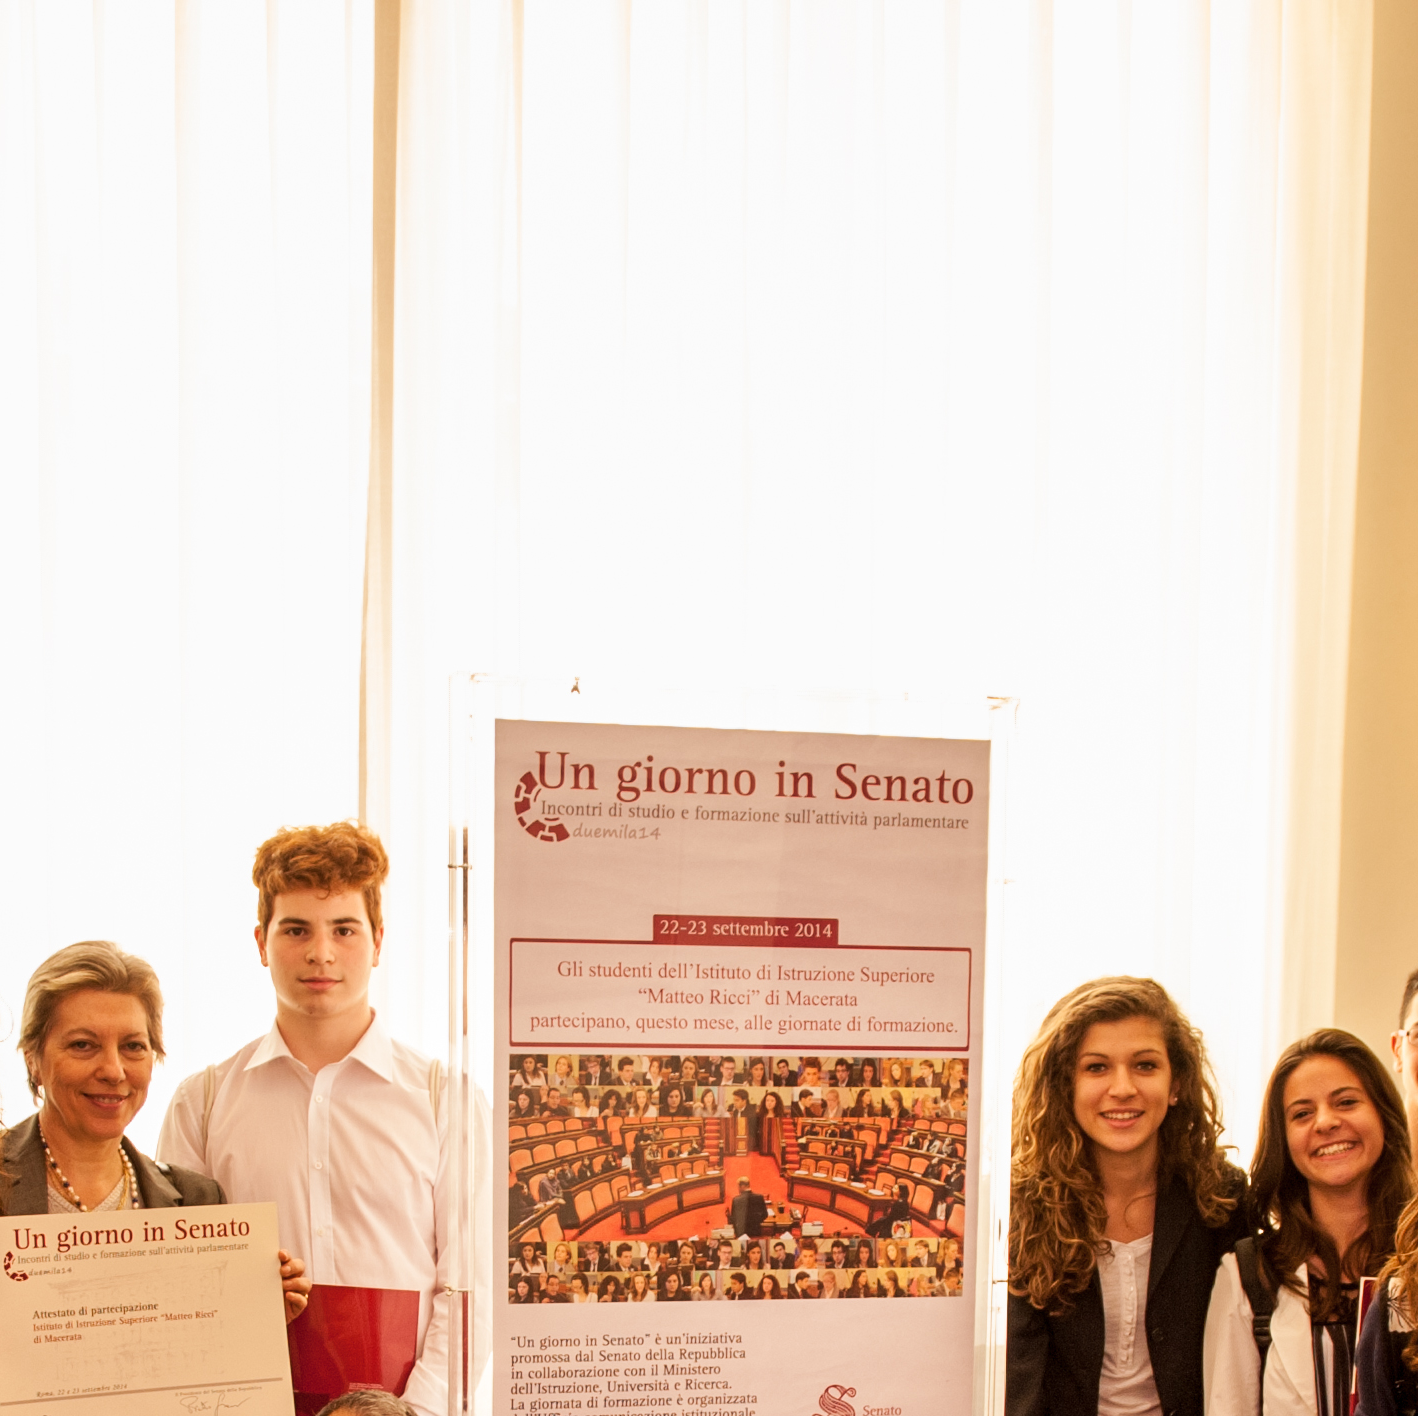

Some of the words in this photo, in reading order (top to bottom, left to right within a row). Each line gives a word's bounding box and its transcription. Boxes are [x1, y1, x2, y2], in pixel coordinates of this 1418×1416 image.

[534, 750, 598, 790] Un
[616, 755, 756, 803] giorno
[775, 760, 816, 798] in
[834, 762, 973, 804] Senato
[541, 800, 603, 818] Incontri
[608, 803, 623, 818] di
[629, 804, 675, 820] studio
[680, 809, 689, 819] e
[695, 806, 780, 823] formazione
[873, 812, 968, 830] parlamentare
[572, 822, 661, 840] duemila14
[660, 919, 706, 934] 22-23
[713, 920, 789, 936] settembre
[795, 922, 832, 937] 2014
[557, 960, 582, 977] Gli
[589, 961, 652, 978] studenti
[756, 964, 770, 980] di
[777, 965, 855, 982] Istruzione
[860, 966, 934, 986] Superiore
[765, 989, 779, 1005] di
[785, 990, 857, 1006] Macerata
[530, 1012, 630, 1032] partecipano,
[635, 1016, 688, 1033] questo
[693, 1018, 738, 1032] mese,
[744, 1014, 772, 1030] alle
[777, 1014, 841, 1034] giornate
[846, 1015, 861, 1031] di
[867, 1016, 957, 1033] formazione.
[13, 1228, 47, 1249] Un
[57, 1225, 133, 1252] giorno
[143, 1221, 165, 1242] in
[175, 1218, 249, 1240] Senato
[17, 1254, 51, 1264] Incontri
[53, 1252, 61, 1262] di
[64, 1251, 90, 1261] studio
[92, 1252, 97, 1260] e
[100, 1248, 146, 1259] formazione
[196, 1243, 248, 1255] parlamentare
[32, 1309, 75, 1319] Attestato
[78, 1306, 87, 1316] di
[91, 1302, 158, 1317] partecipazione
[33, 1322, 63, 1332] Istituto
[65, 1320, 73, 1329] di
[76, 1318, 116, 1328] Istruzione
[119, 1315, 158, 1326] Superiore
[33, 1335, 41, 1344] di
[44, 1333, 82, 1343] Macerata
[539, 1336, 581, 1350] giorno
[585, 1334, 597, 1346] in
[655, 1334, 662, 1344] è
[511, 1353, 570, 1367] promossa
[575, 1350, 593, 1362] dal
[599, 1350, 640, 1362] Senato
[645, 1349, 674, 1360] della
[679, 1348, 745, 1362] Repubblica
[511, 1366, 523, 1379] in
[527, 1366, 619, 1379] collaborazione
[623, 1367, 645, 1376] con
[651, 1364, 658, 1376] il
[663, 1363, 721, 1375] Ministero
[607, 1379, 669, 1392] Università
[674, 1382, 680, 1390] e
[685, 1378, 732, 1390] Ricerca.
[510, 1398, 525, 1410] La
[529, 1398, 581, 1413] giornata
[586, 1396, 598, 1408] di
[603, 1395, 672, 1408] formazione
[676, 1393, 683, 1405] è
[687, 1393, 757, 1408] organizzata
[862, 1405, 901, 1416] Senato
